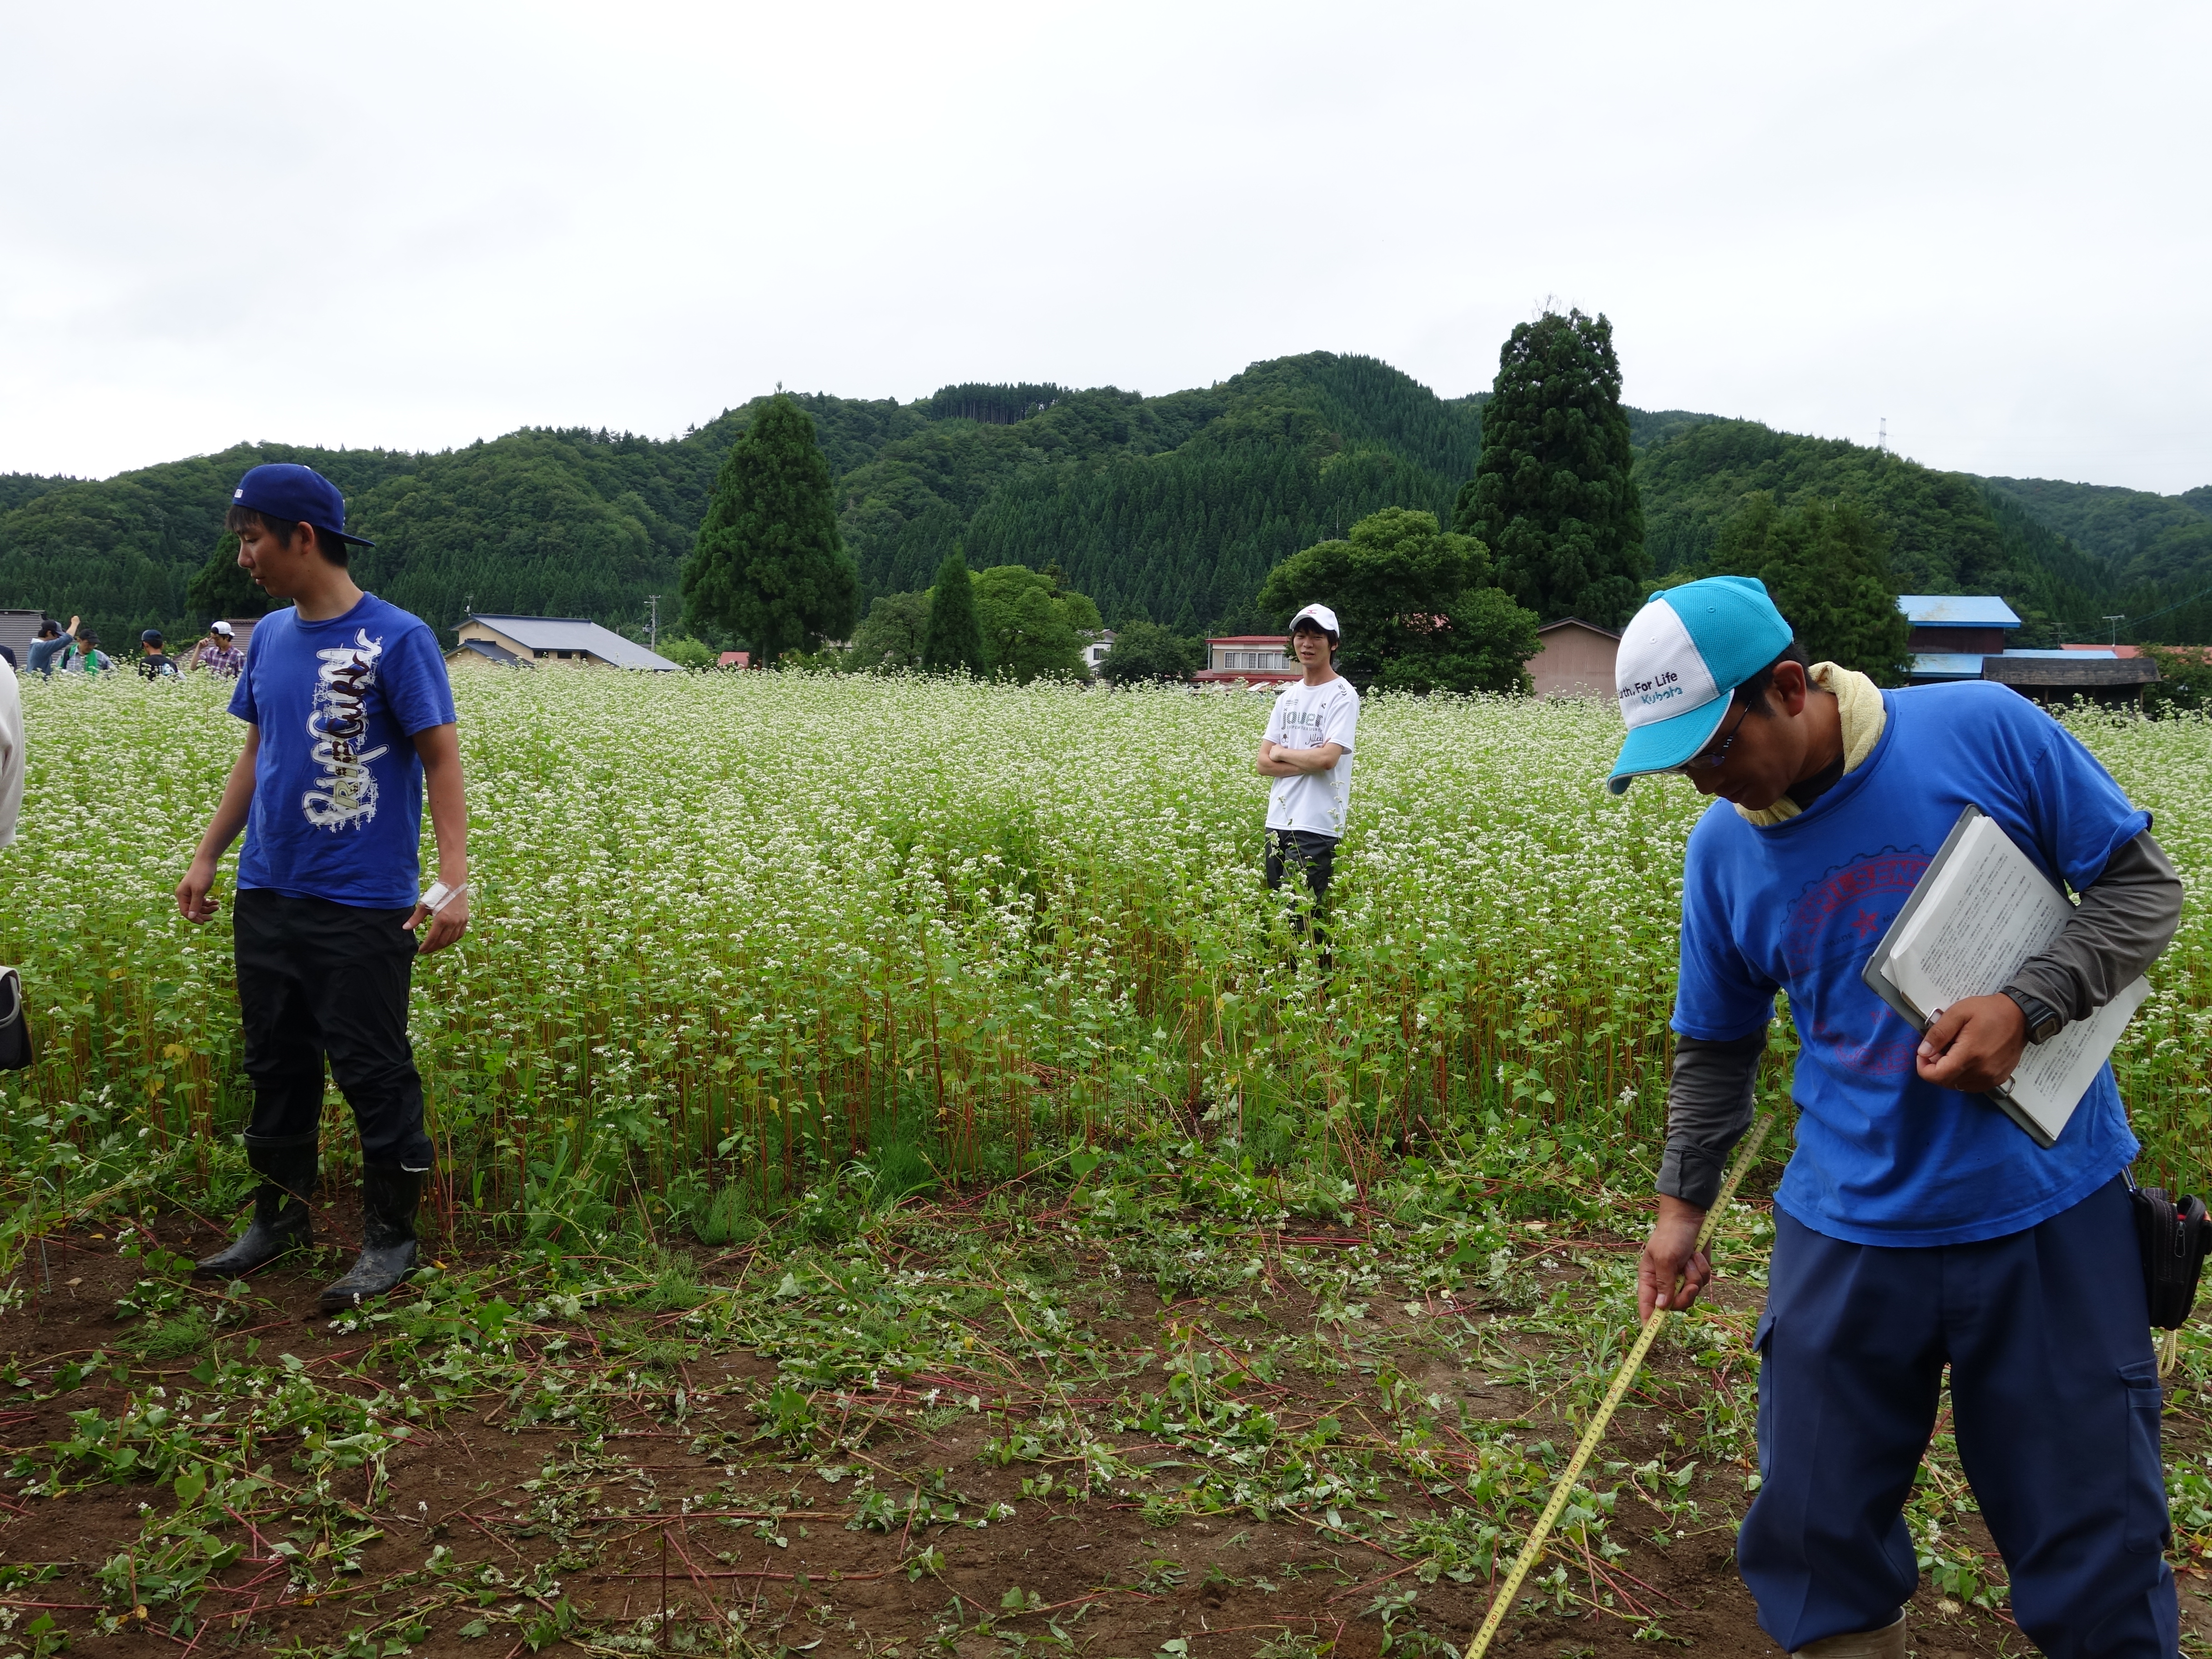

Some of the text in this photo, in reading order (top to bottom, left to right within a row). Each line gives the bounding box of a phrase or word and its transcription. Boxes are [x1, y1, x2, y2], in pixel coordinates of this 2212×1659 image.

[1634, 681, 1652, 694] For
[1655, 672, 1678, 687] Life
[1641, 686, 1683, 704] Kubota
[1281, 708, 1323, 730] jouer
[1728, 1178, 1736, 1187] 90
[1489, 1614, 1497, 1625] 30
[1527, 1535, 1536, 1548] 40
[1570, 1463, 1579, 1474] 50
[1608, 1387, 1616, 1399] 60
[1650, 1319, 1658, 1329] 70
